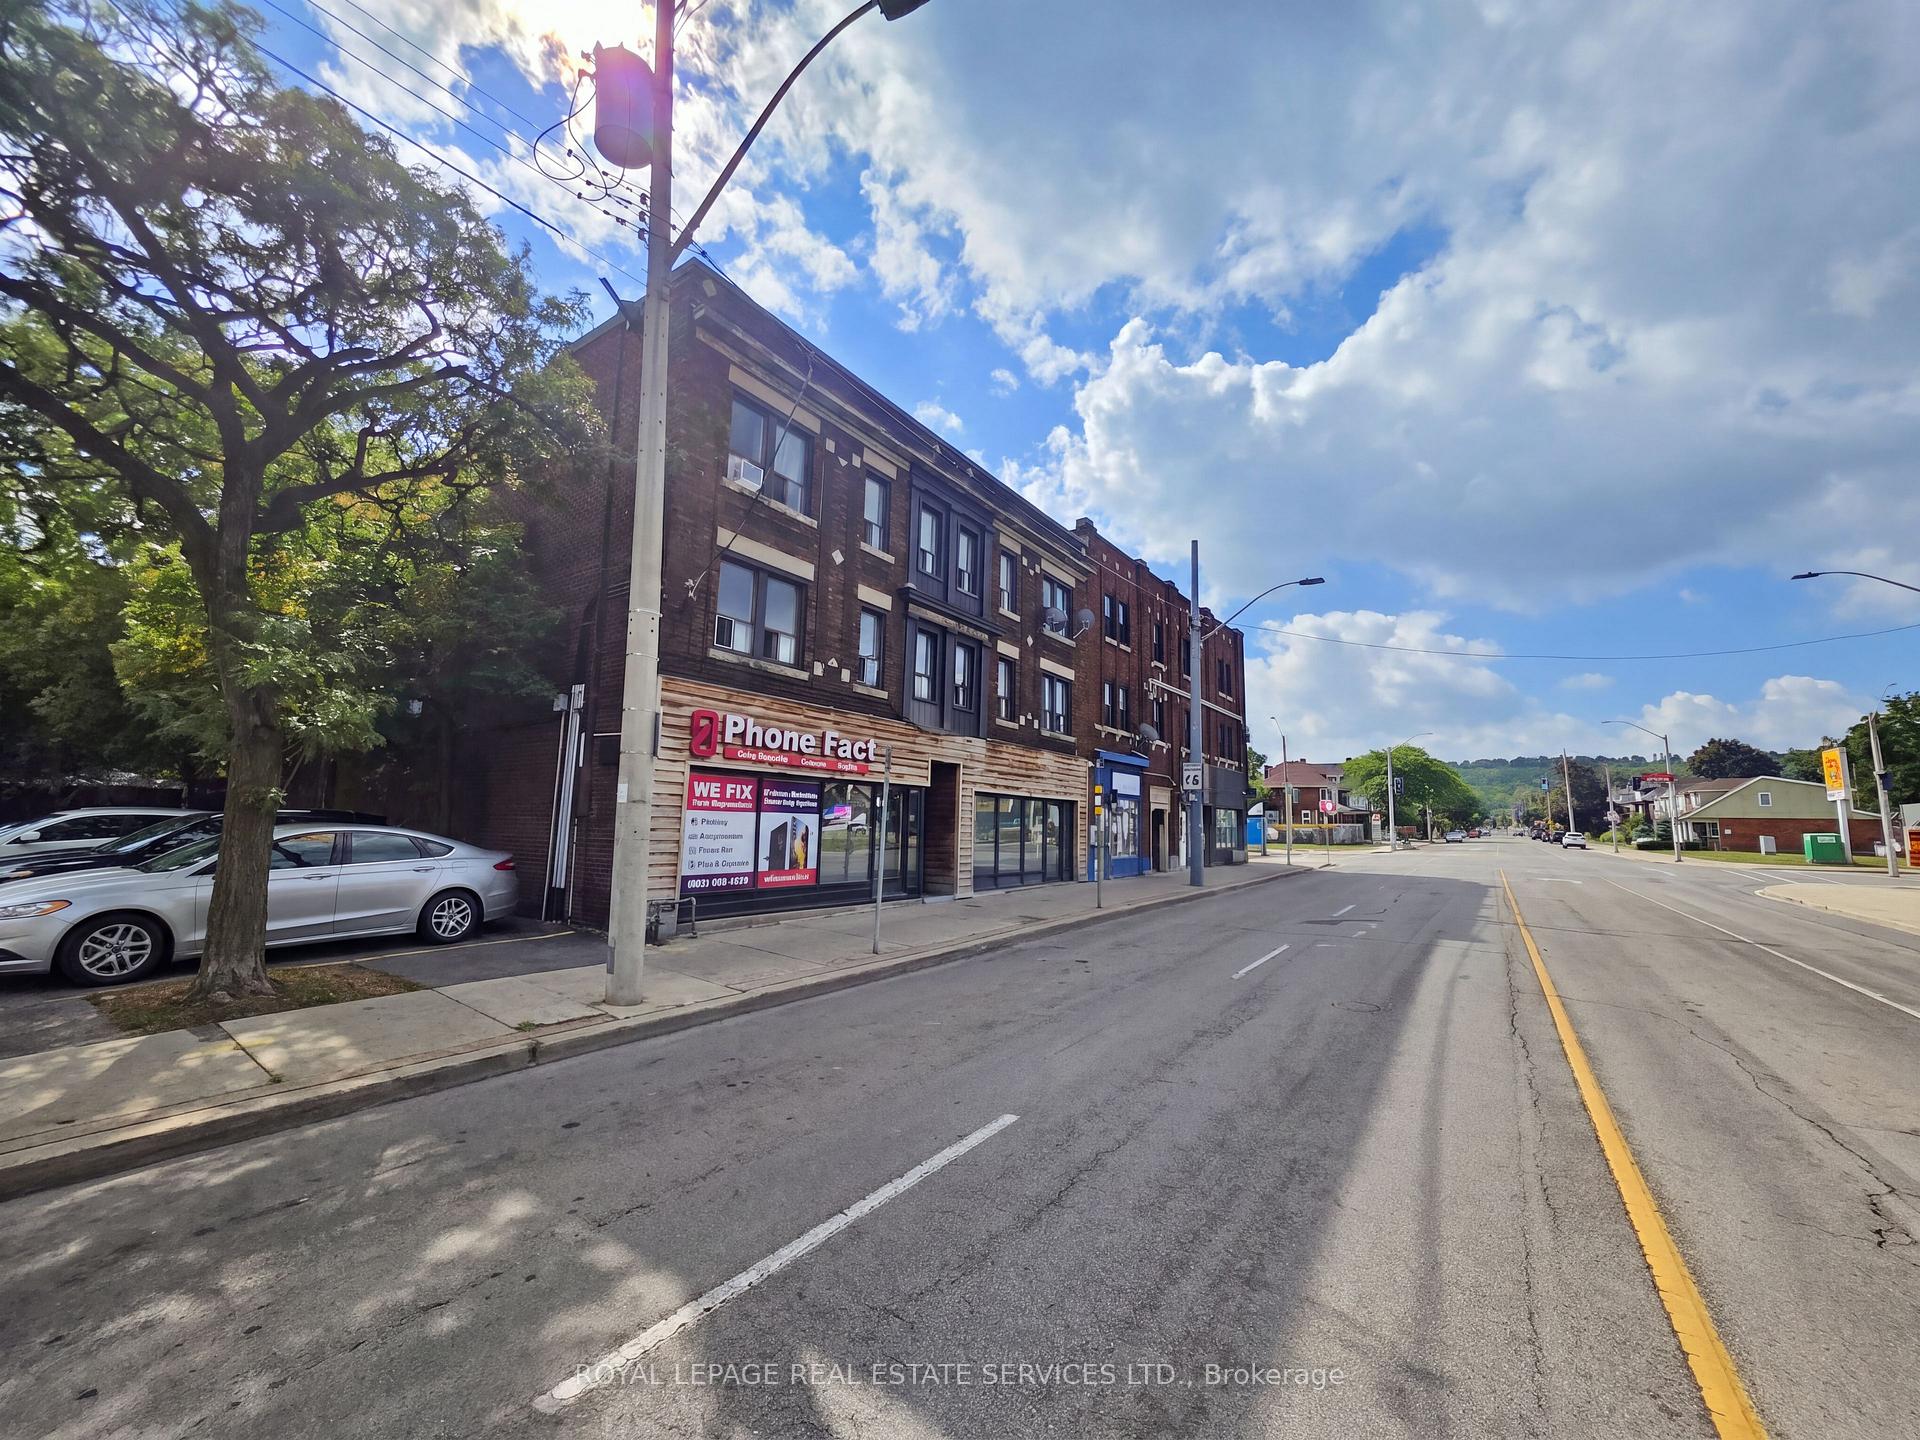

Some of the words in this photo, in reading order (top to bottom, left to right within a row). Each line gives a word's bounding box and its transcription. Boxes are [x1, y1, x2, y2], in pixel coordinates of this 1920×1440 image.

[724, 713, 816, 754] Phone
[823, 730, 878, 761] Fact
[693, 780, 721, 799] WE
[725, 783, 753, 800] FIX
